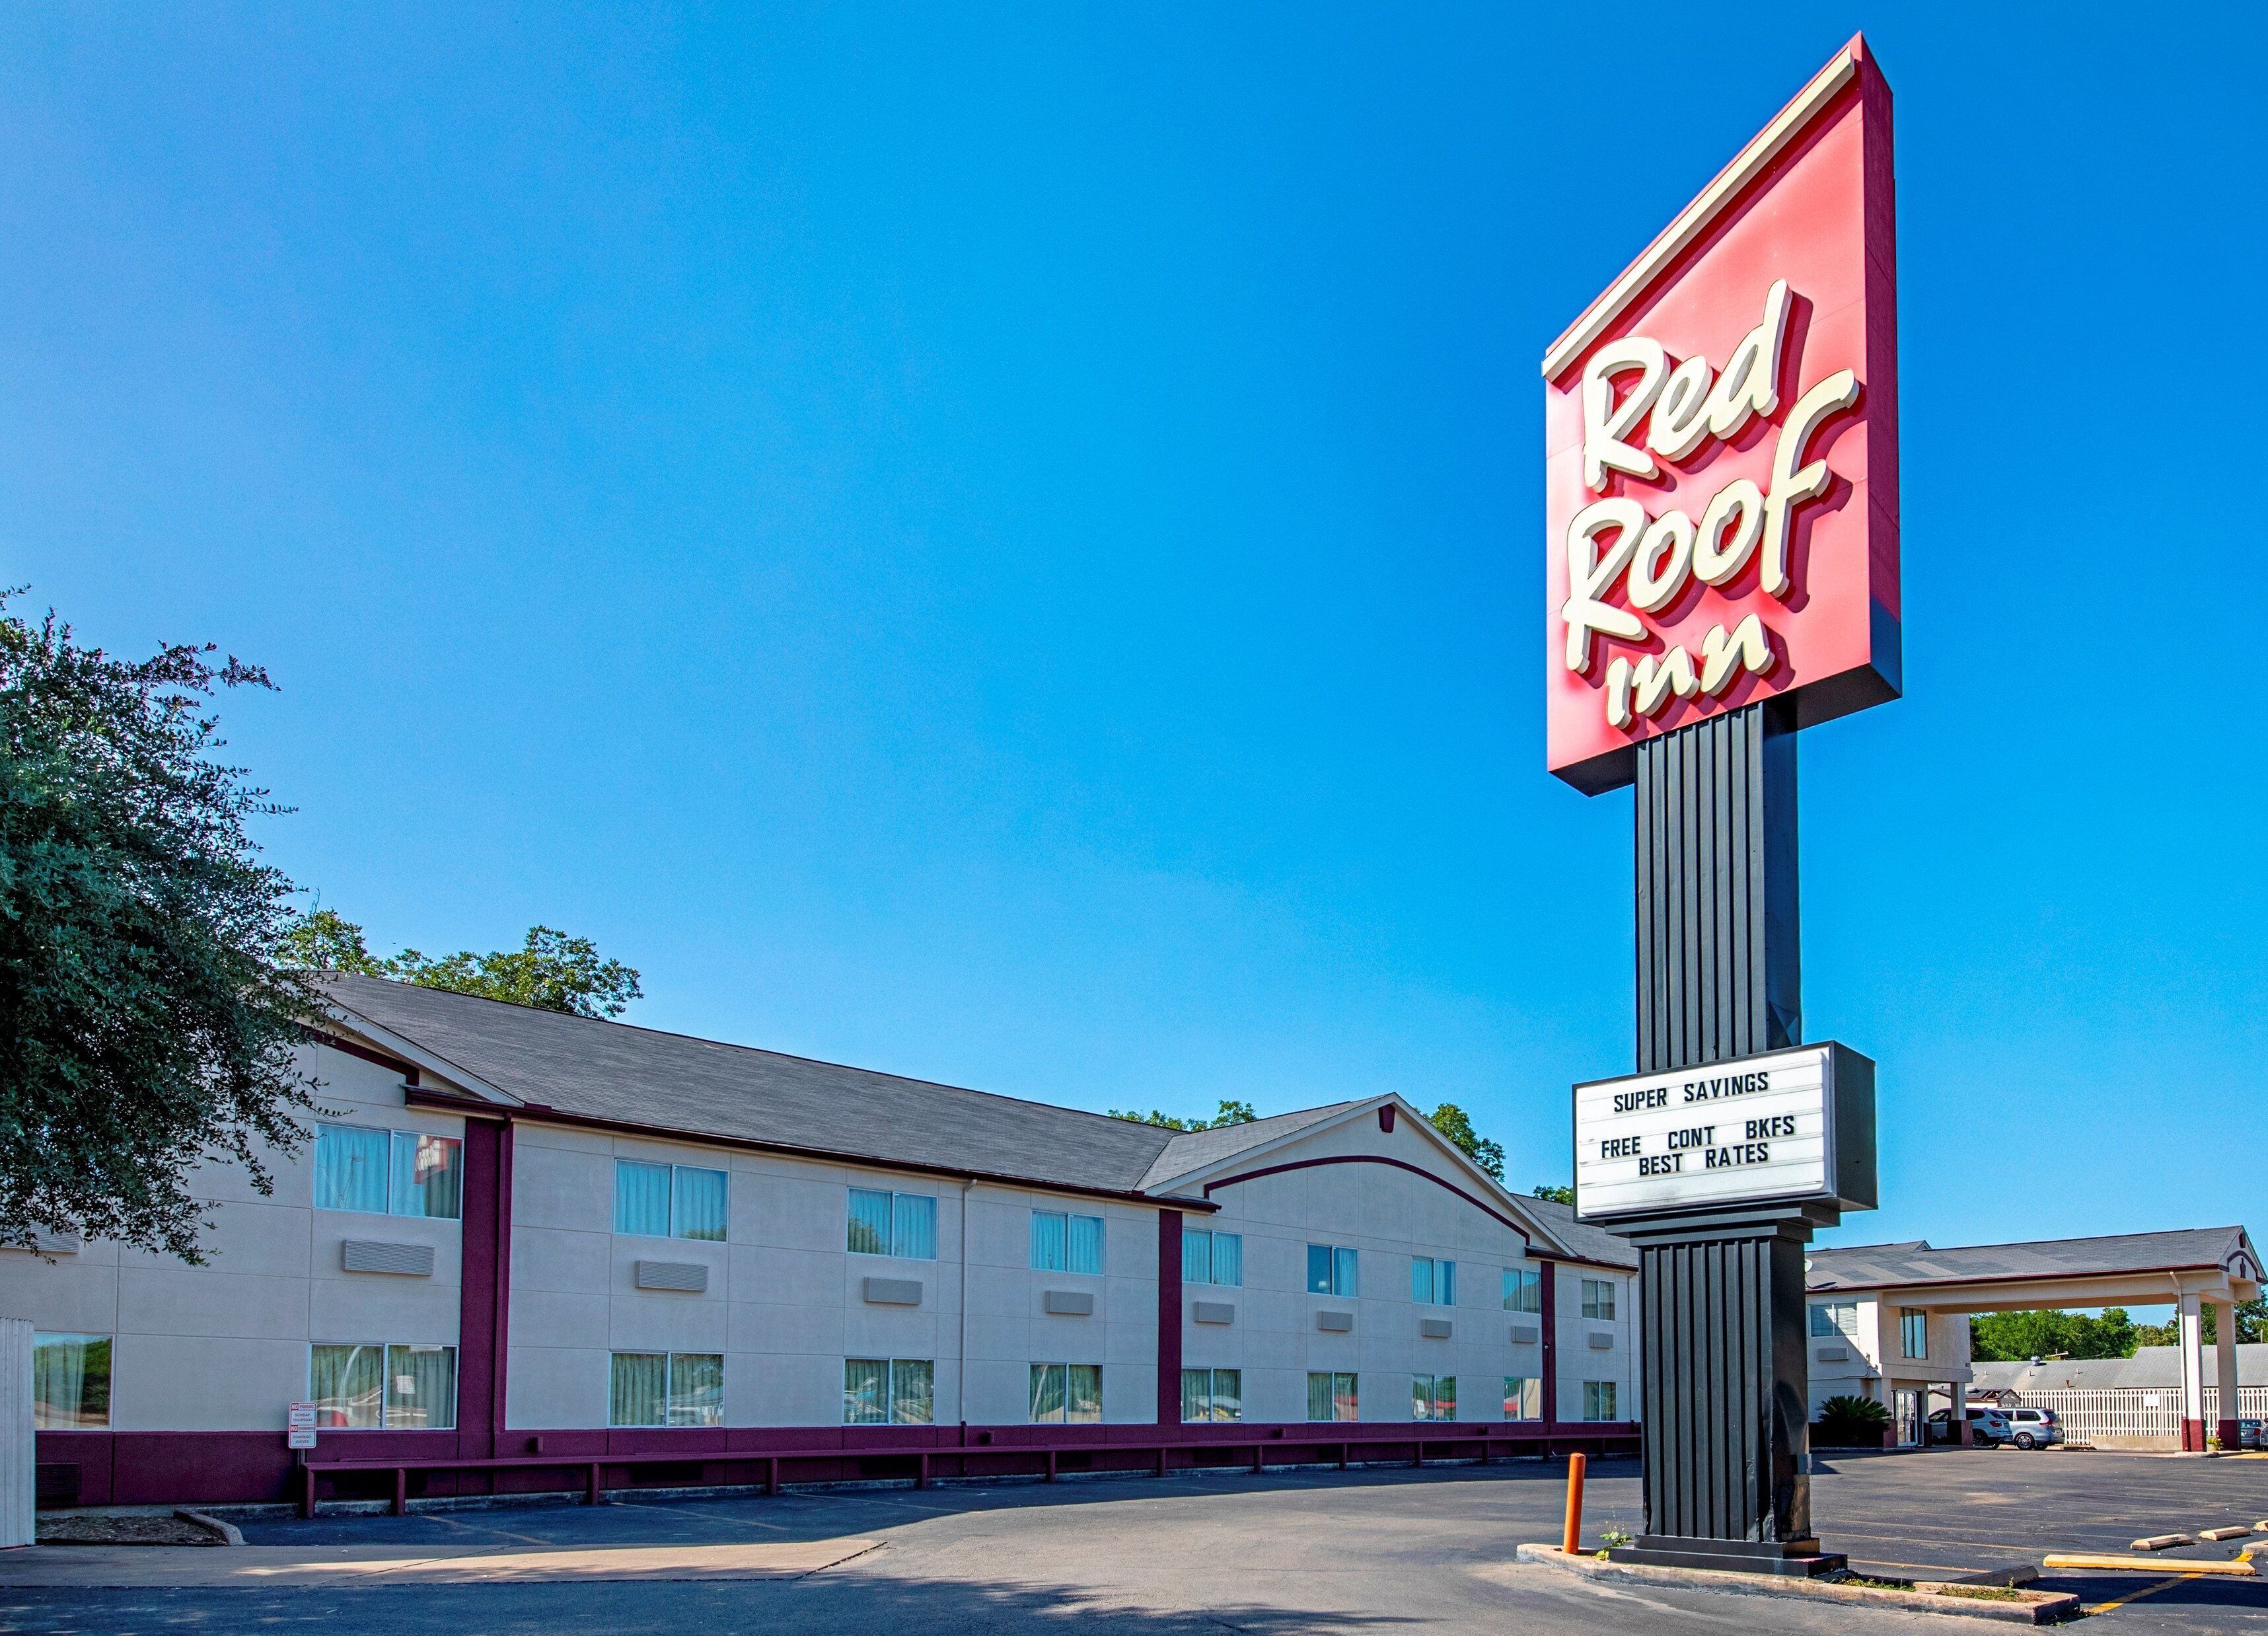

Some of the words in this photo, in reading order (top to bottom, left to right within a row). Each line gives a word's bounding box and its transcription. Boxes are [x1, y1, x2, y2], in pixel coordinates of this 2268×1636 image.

[1582, 278, 1790, 493] Red
[1561, 368, 1860, 672] Roof
[1614, 1088, 1667, 1113] SUPER
[1684, 1072, 1769, 1102] SAVINGS
[1601, 1136, 1641, 1158] FREE
[1668, 1125, 1715, 1150] CONT
[1746, 1115, 1794, 1139] BKFS
[1639, 1153, 1683, 1175] BEST
[1706, 1142, 1768, 1168] RATES
